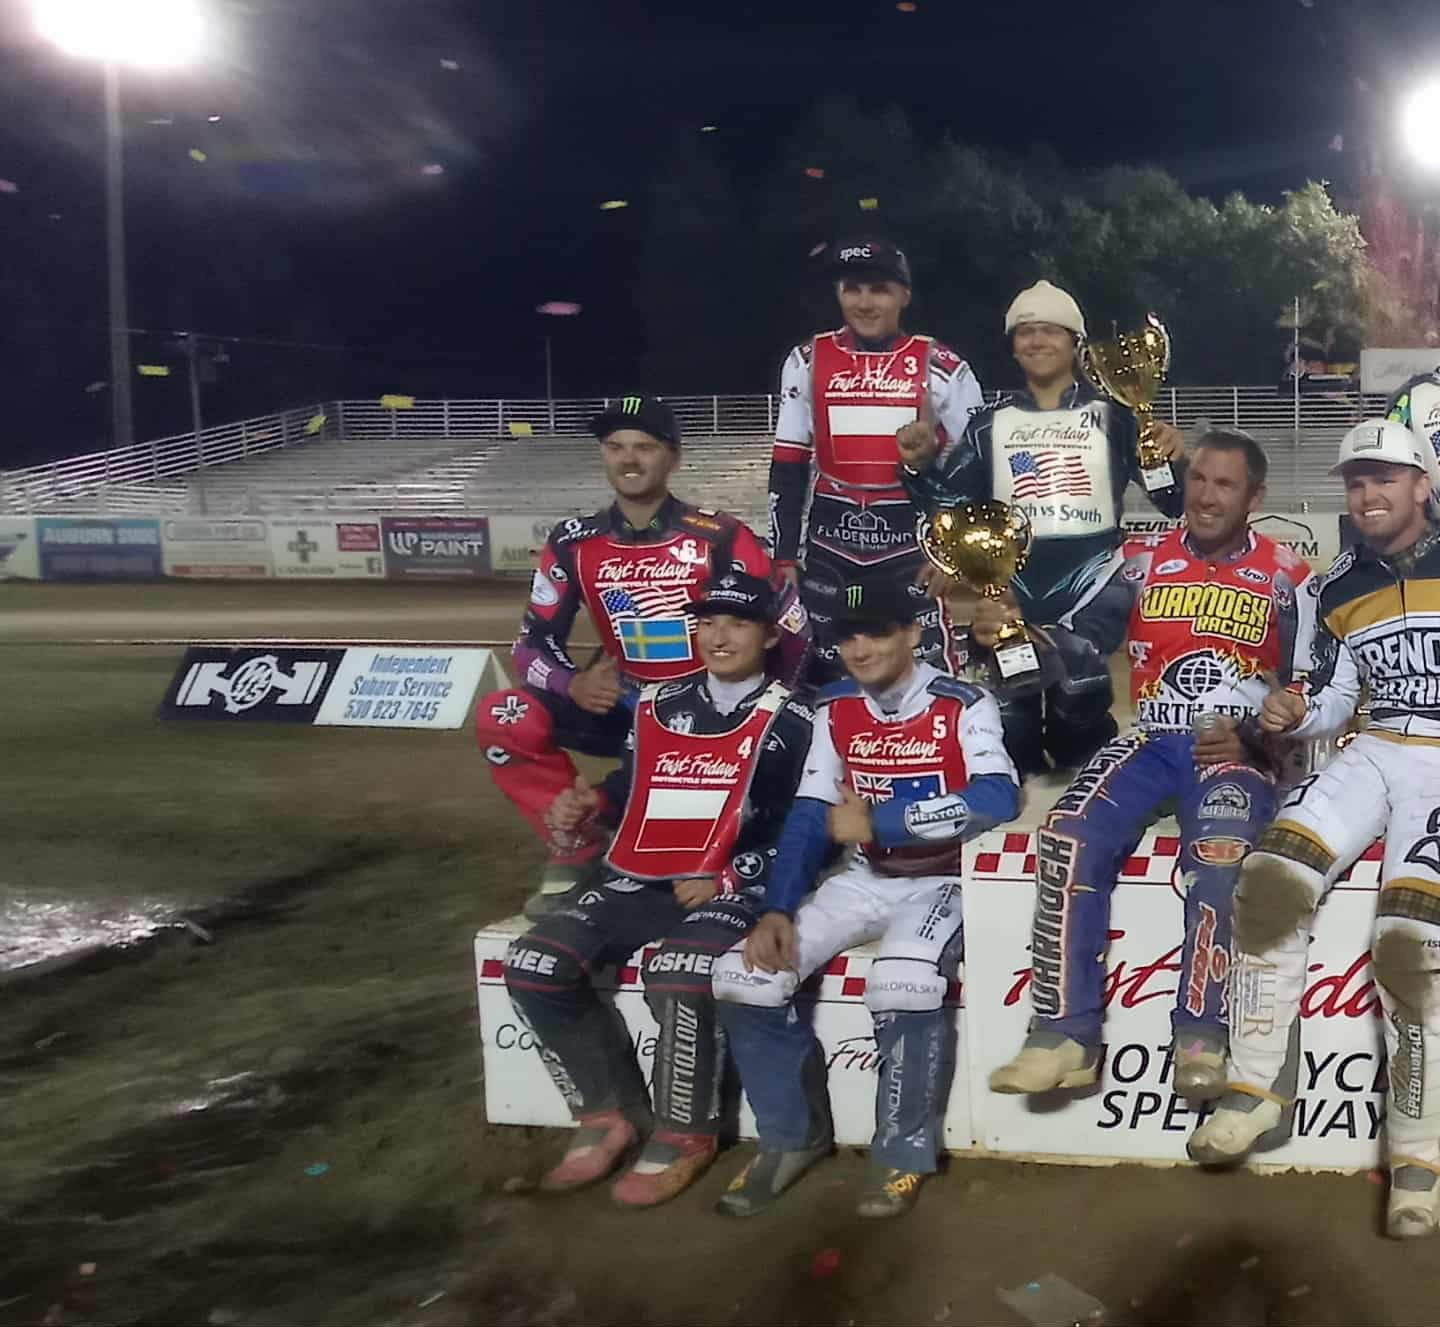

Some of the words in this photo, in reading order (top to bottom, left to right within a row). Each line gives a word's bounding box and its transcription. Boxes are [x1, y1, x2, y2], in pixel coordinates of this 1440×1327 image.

[904, 356, 918, 375] 3
[1080, 412, 1101, 429] 2N
[1060, 503, 1102, 524] South
[420, 541, 483, 556] PAINT
[598, 557, 636, 581] Fast
[634, 559, 695, 581] Fridays
[1143, 584, 1270, 628] WARNOCK
[1195, 617, 1263, 644] RACING
[370, 654, 452, 675] Independent
[350, 676, 398, 698] Subaru
[400, 676, 453, 698] Service
[344, 700, 370, 720] 530
[372, 700, 440, 721] 823-7645
[932, 716, 947, 738] 5
[738, 736, 753, 759] 4
[849, 732, 885, 757] Fast
[881, 733, 940, 759] Fridays
[655, 751, 692, 776] Fast
[690, 753, 740, 778] Fridays
[648, 951, 714, 974] OSHE
